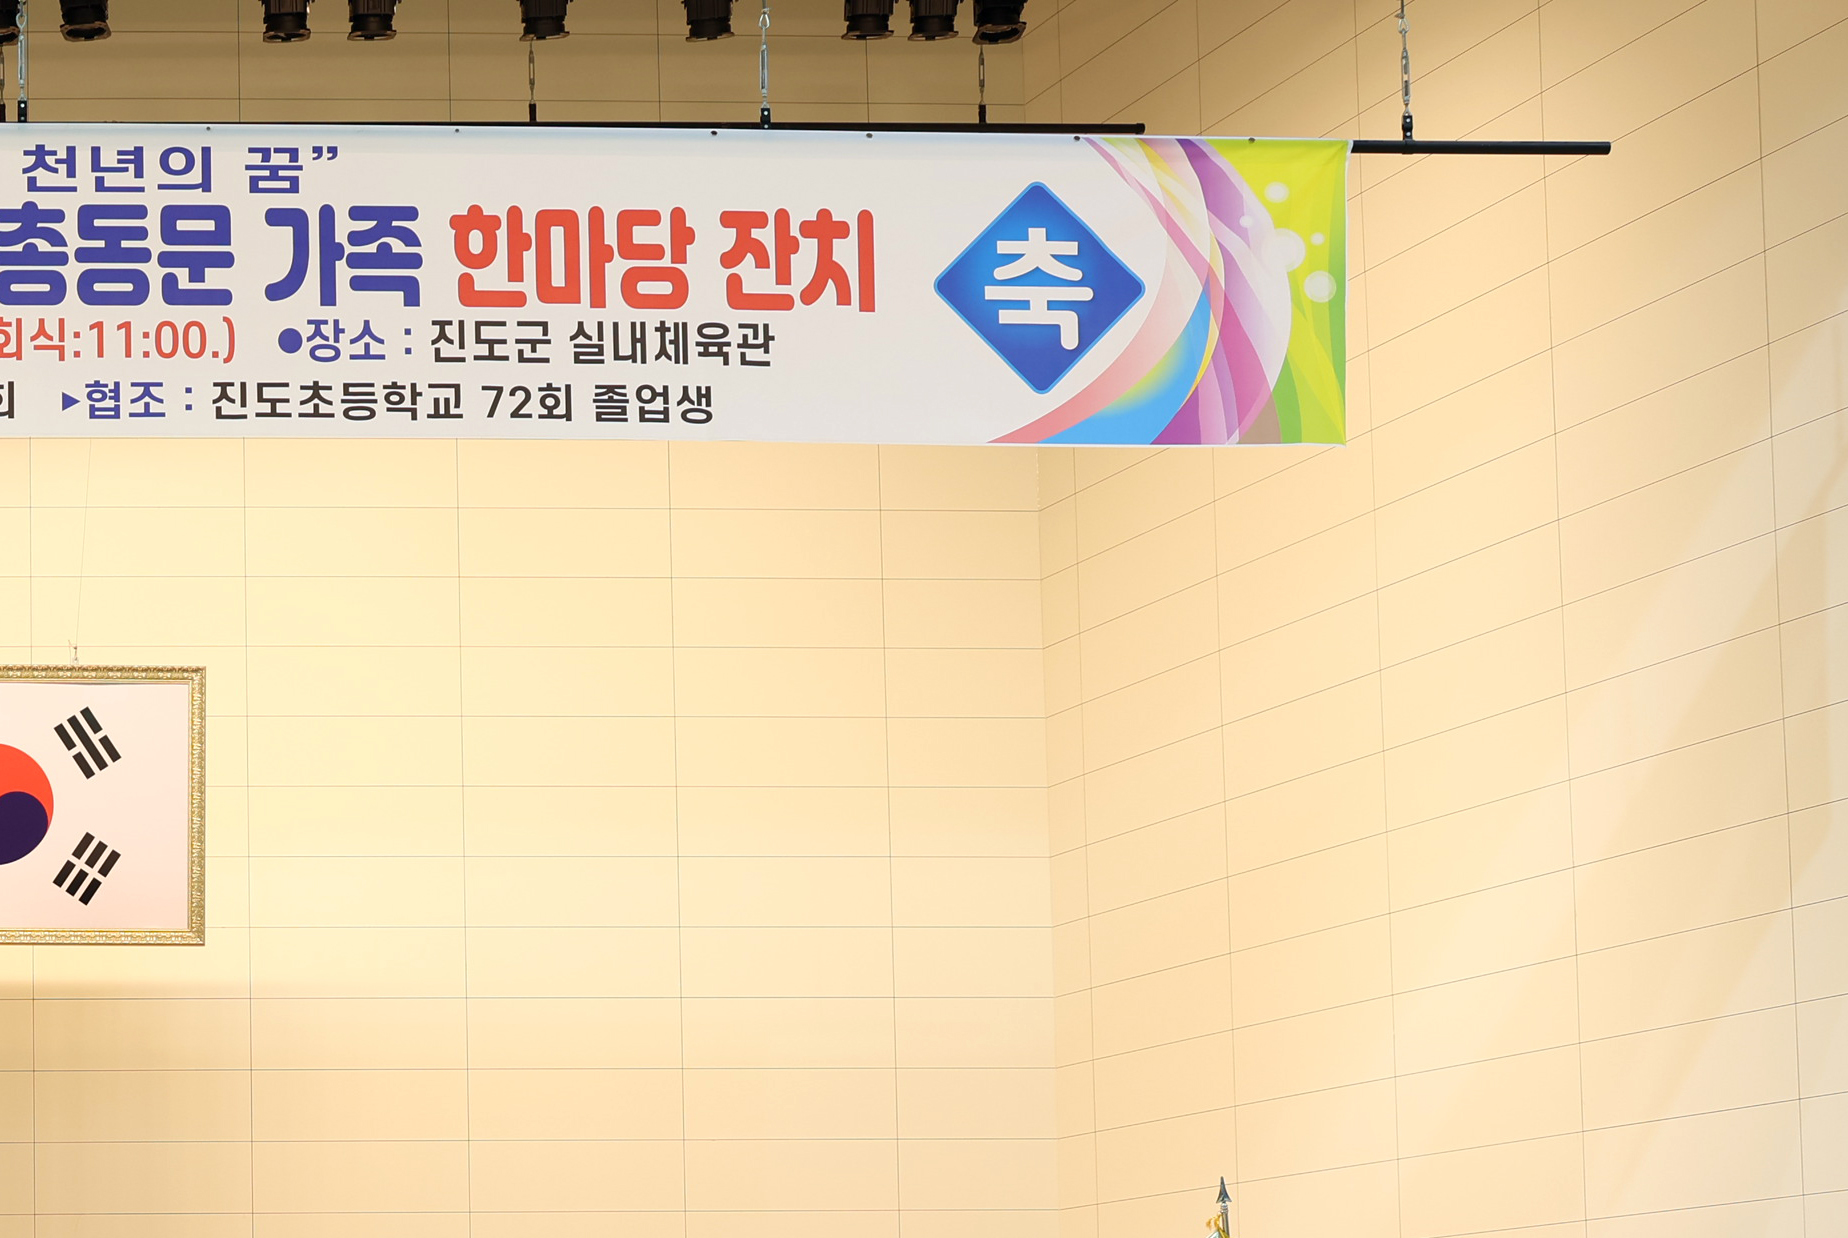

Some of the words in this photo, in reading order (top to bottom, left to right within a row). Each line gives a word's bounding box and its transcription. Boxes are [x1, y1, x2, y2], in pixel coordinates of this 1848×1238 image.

[22, 144, 211, 192] 천년의
[265, 204, 423, 307] 가족
[449, 204, 695, 309] 한마당
[720, 208, 875, 312] 잔치
[984, 226, 1094, 350] 축
[431, 320, 551, 363] 진도군
[570, 320, 775, 367] 실내체육관
[212, 381, 463, 421] 진도초등학교
[482, 383, 572, 421] 72회
[593, 384, 713, 424] 졸업생
